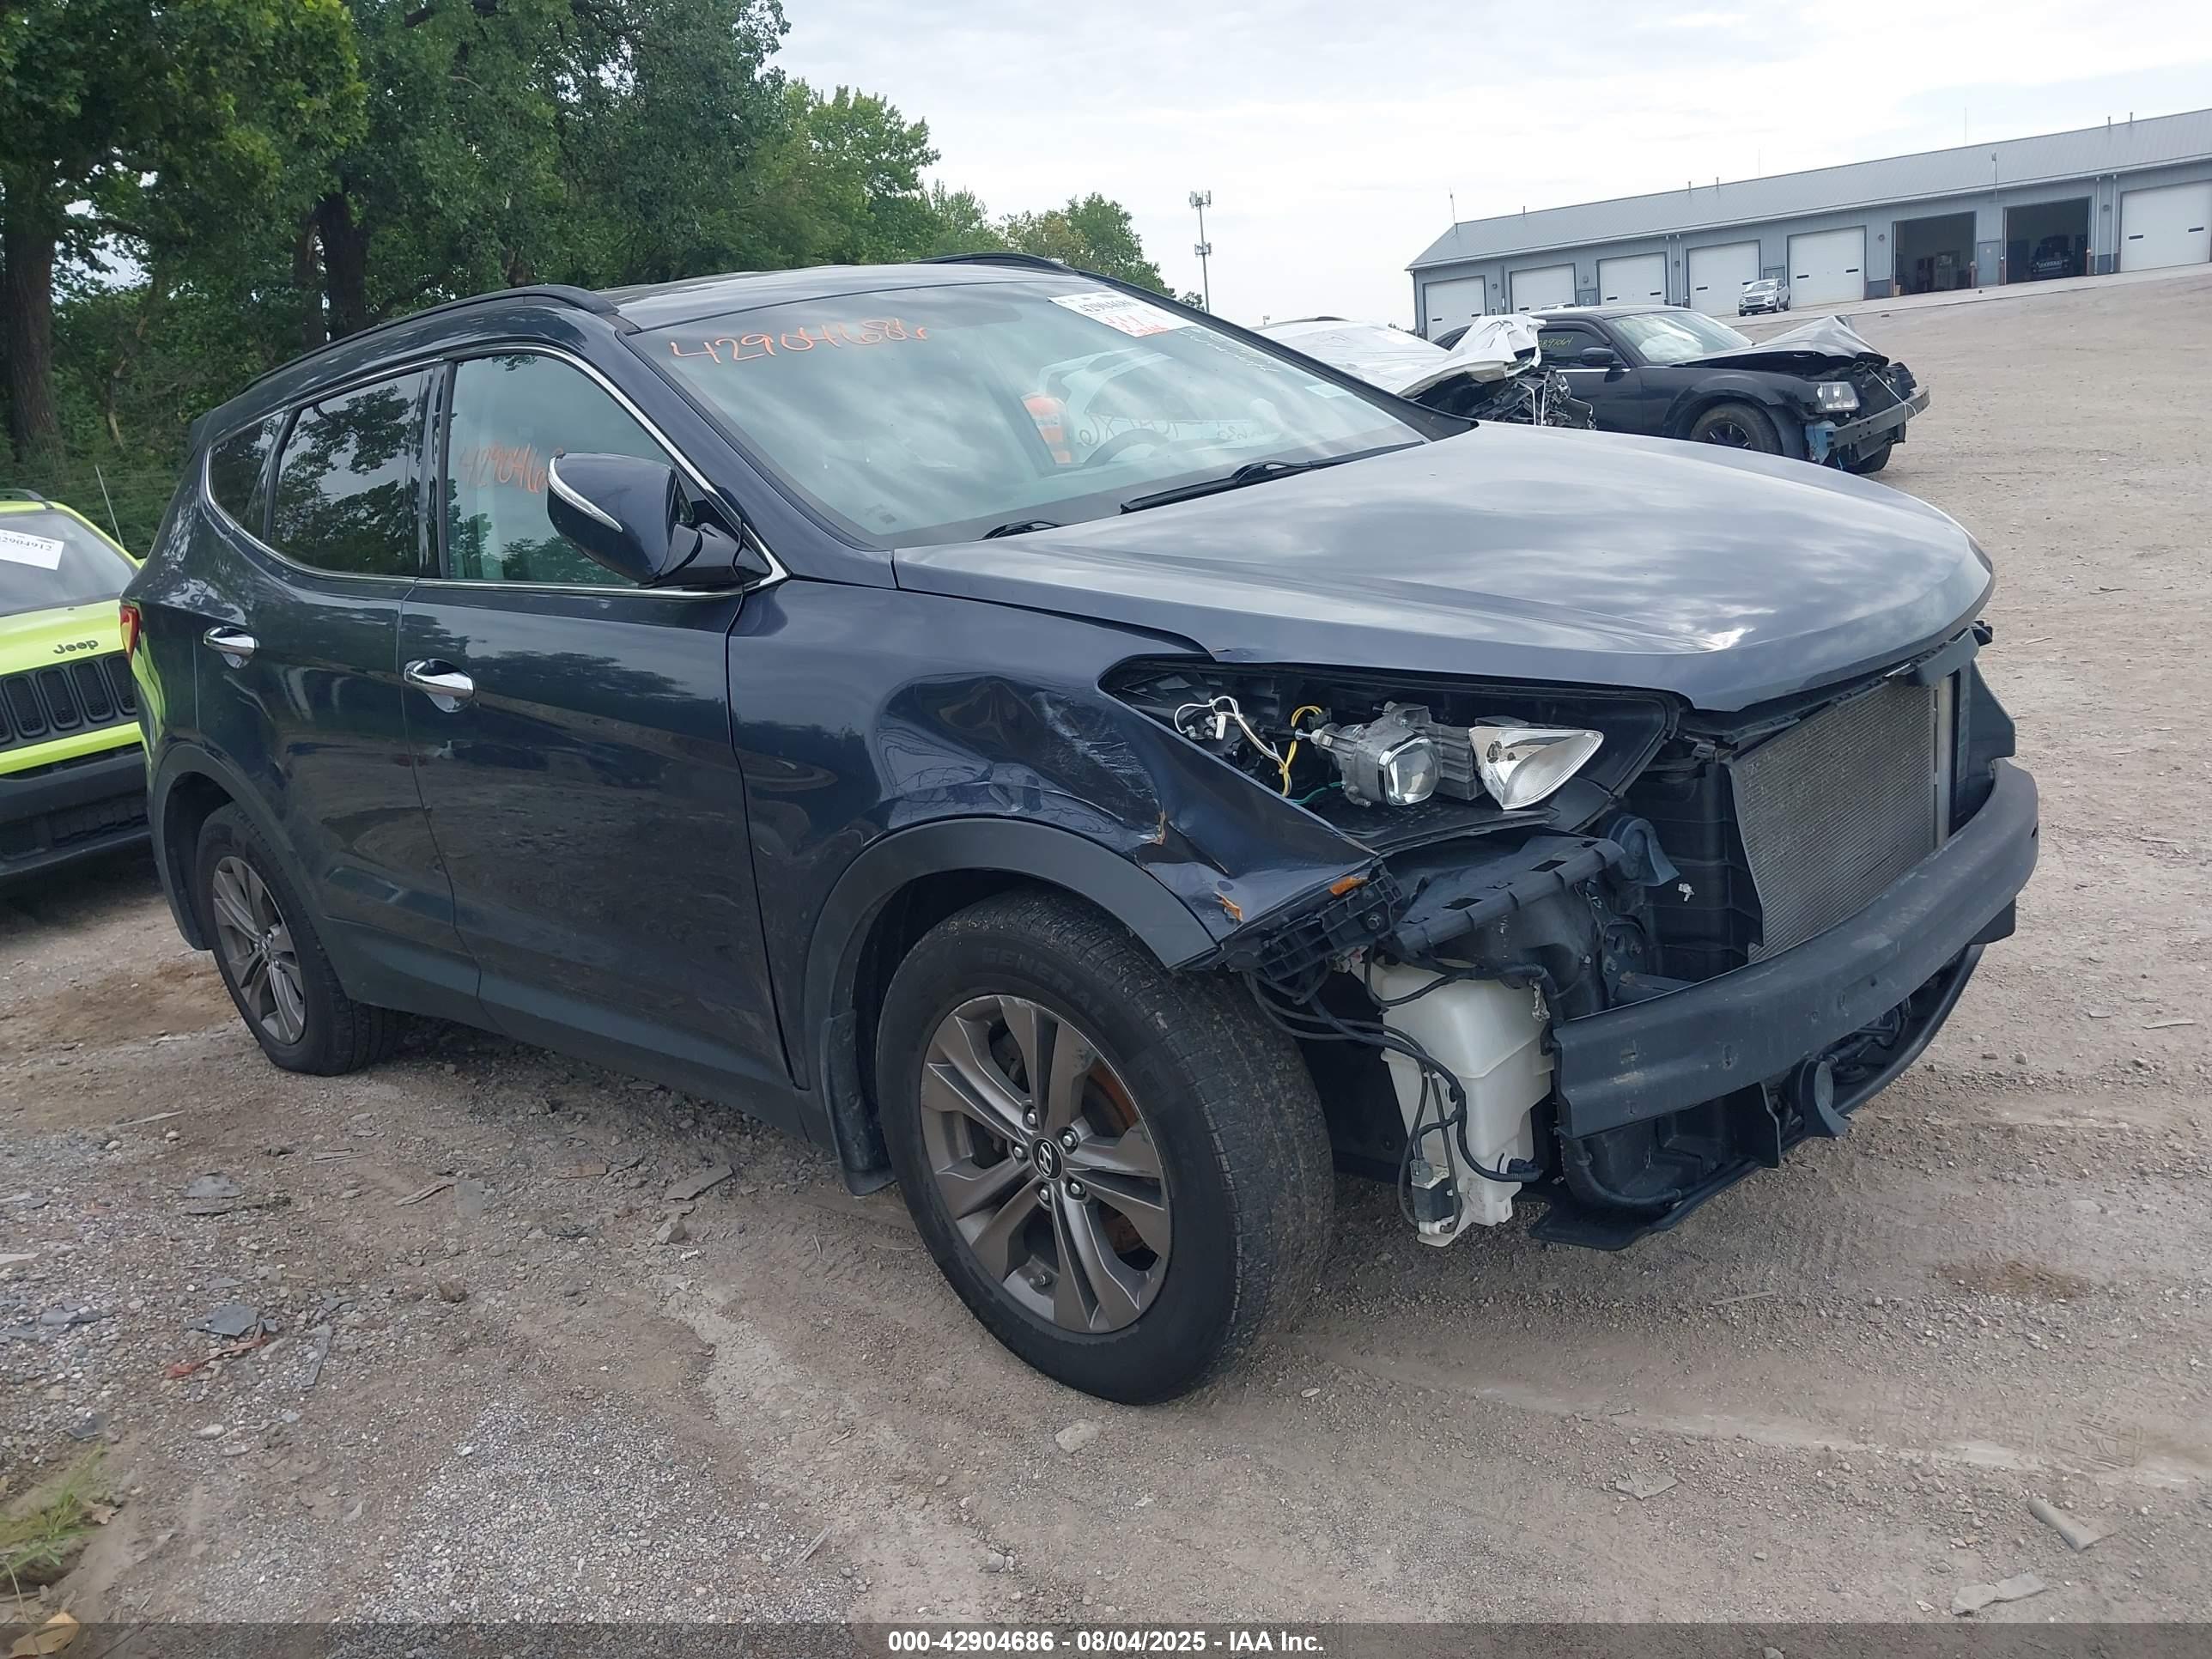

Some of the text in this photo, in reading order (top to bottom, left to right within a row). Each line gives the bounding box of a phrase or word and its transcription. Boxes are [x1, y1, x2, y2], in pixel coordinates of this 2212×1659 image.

[670, 317, 928, 364] 42904686
[0, 536, 52, 550] 2904912
[52, 640, 99, 654] Jeep
[981, 946, 1108, 1027] GENERAL
